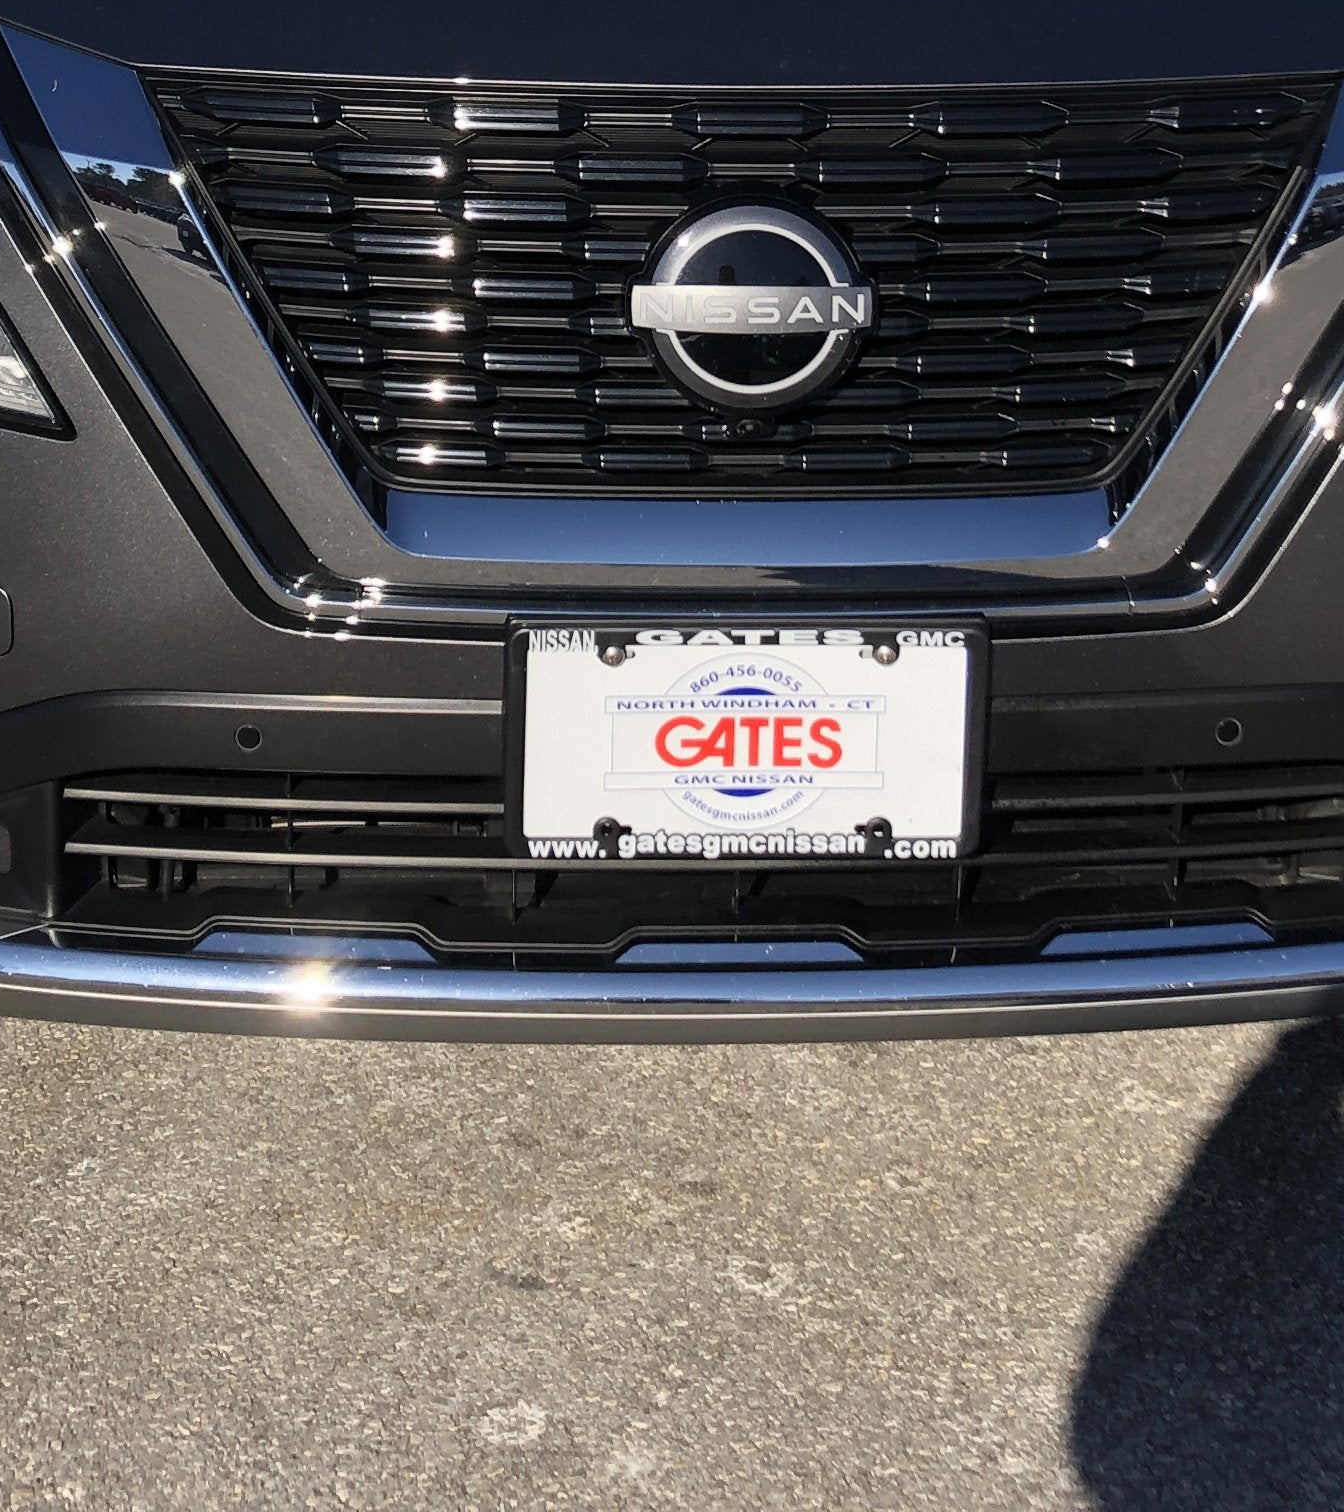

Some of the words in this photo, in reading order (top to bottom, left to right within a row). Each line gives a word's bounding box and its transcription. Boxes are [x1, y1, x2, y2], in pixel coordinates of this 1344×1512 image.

[639, 292, 866, 324] NISSAN
[528, 629, 596, 653] NISSAN
[635, 629, 864, 646] GATES
[896, 630, 966, 647] GMC
[689, 663, 803, 694] 860-456-0055
[616, 700, 695, 710] NORTH
[701, 699, 817, 709] WINDHAM
[847, 699, 875, 709] CT
[655, 715, 843, 769] GATES
[674, 774, 725, 785] GMC
[732, 774, 814, 785] NISSAN
[681, 789, 804, 822] gatesgmcnissan.com
[617, 828, 866, 860] gatesgmcnissan
